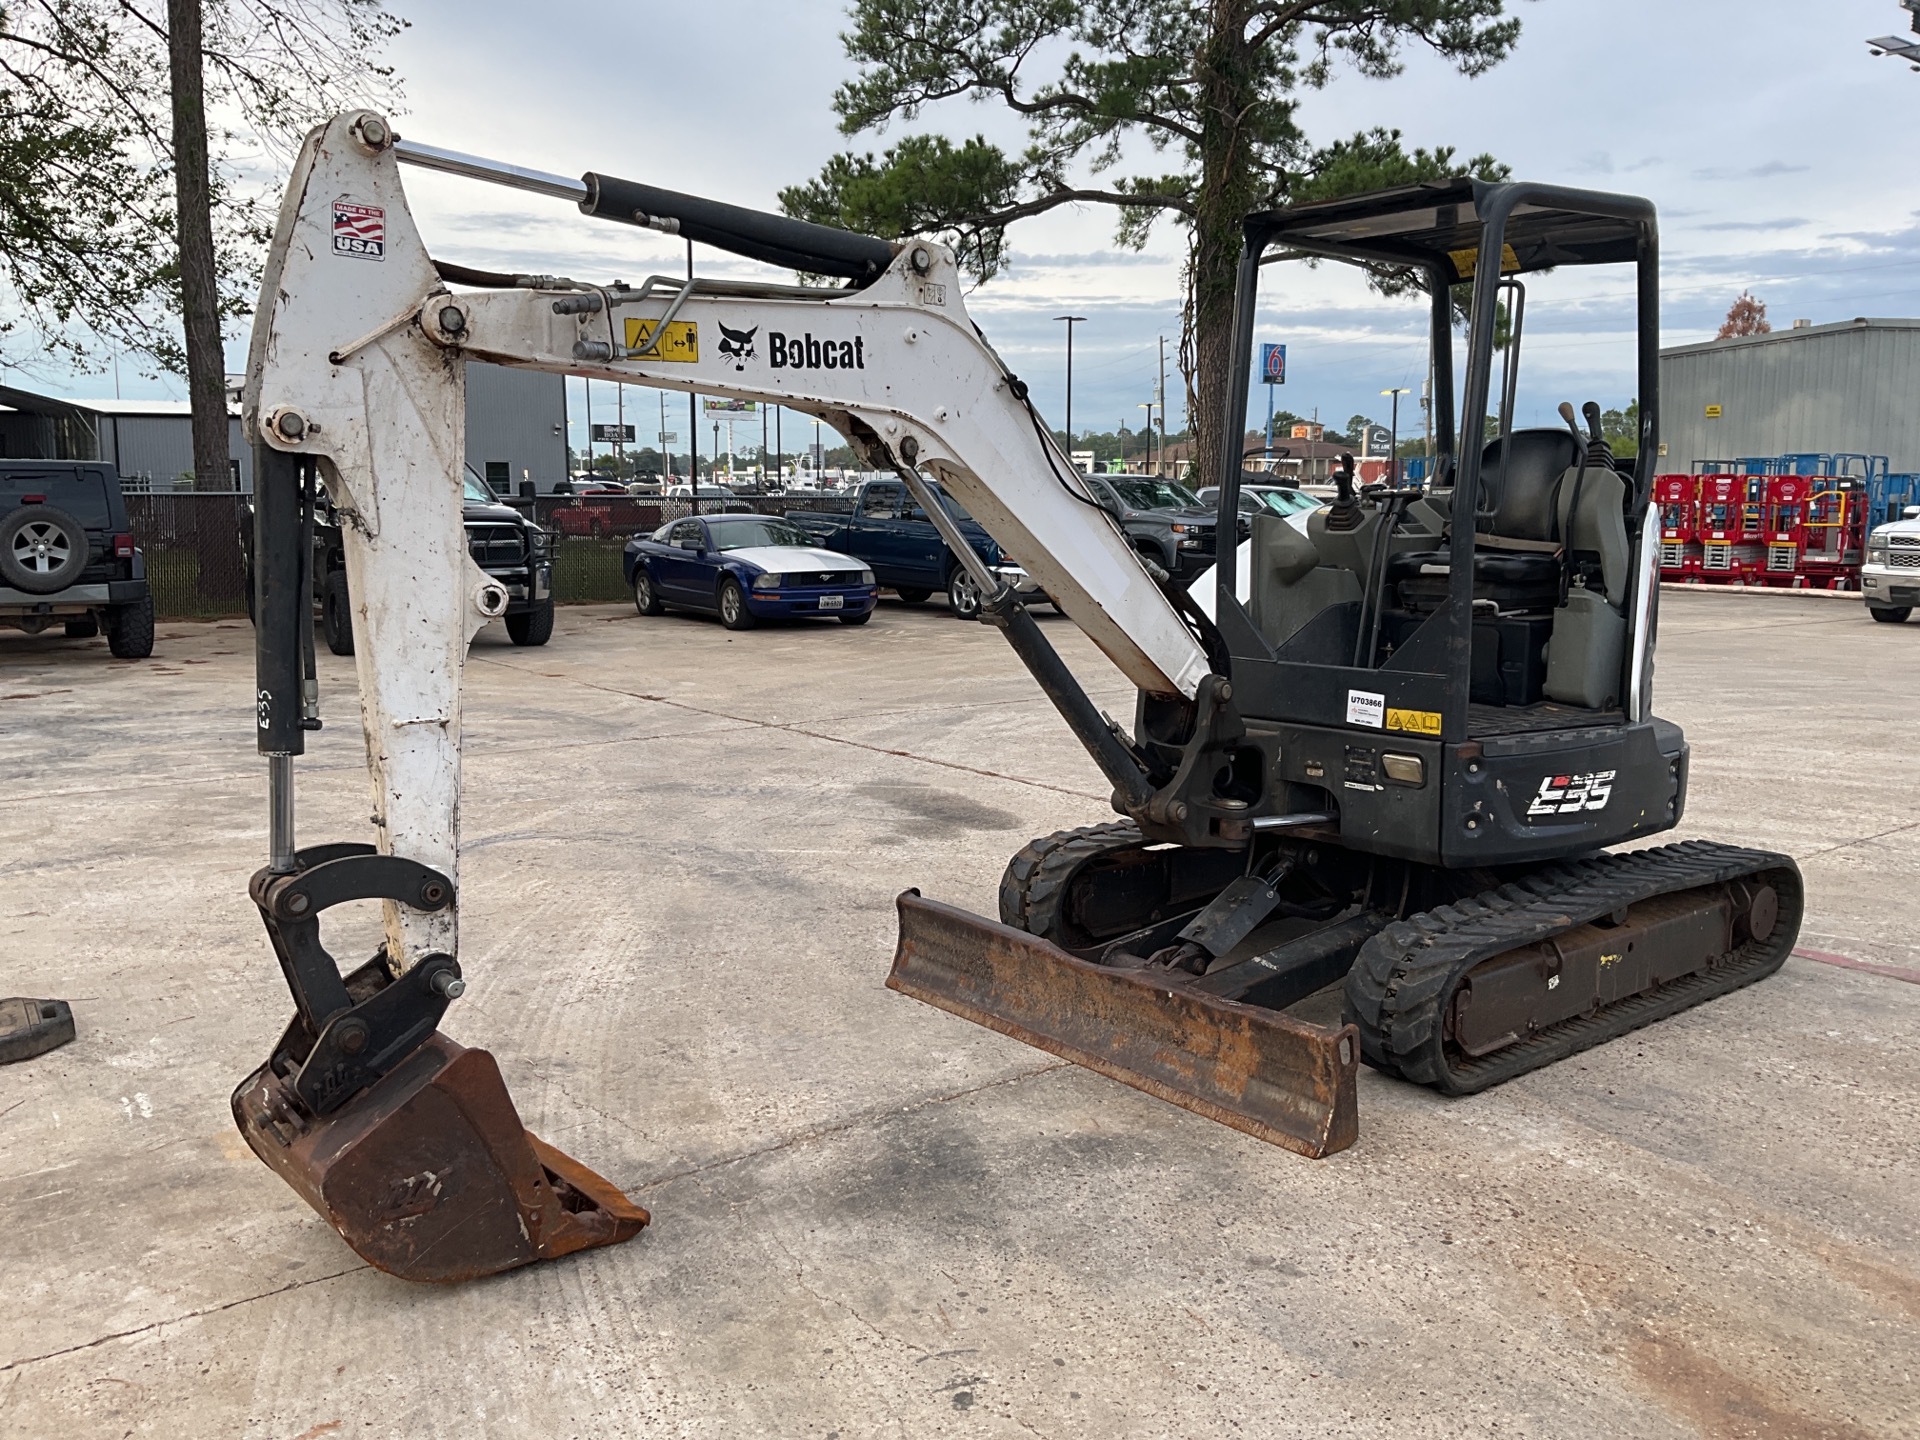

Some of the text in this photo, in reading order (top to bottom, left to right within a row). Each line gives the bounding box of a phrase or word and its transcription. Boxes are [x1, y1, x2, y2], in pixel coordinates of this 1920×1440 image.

[336, 204, 357, 213] MADE
[336, 237, 381, 255] USA
[769, 332, 865, 369] Bobcat
[1267, 345, 1284, 376] 6
[1350, 696, 1383, 708] U703866
[1526, 769, 1616, 815] E35
